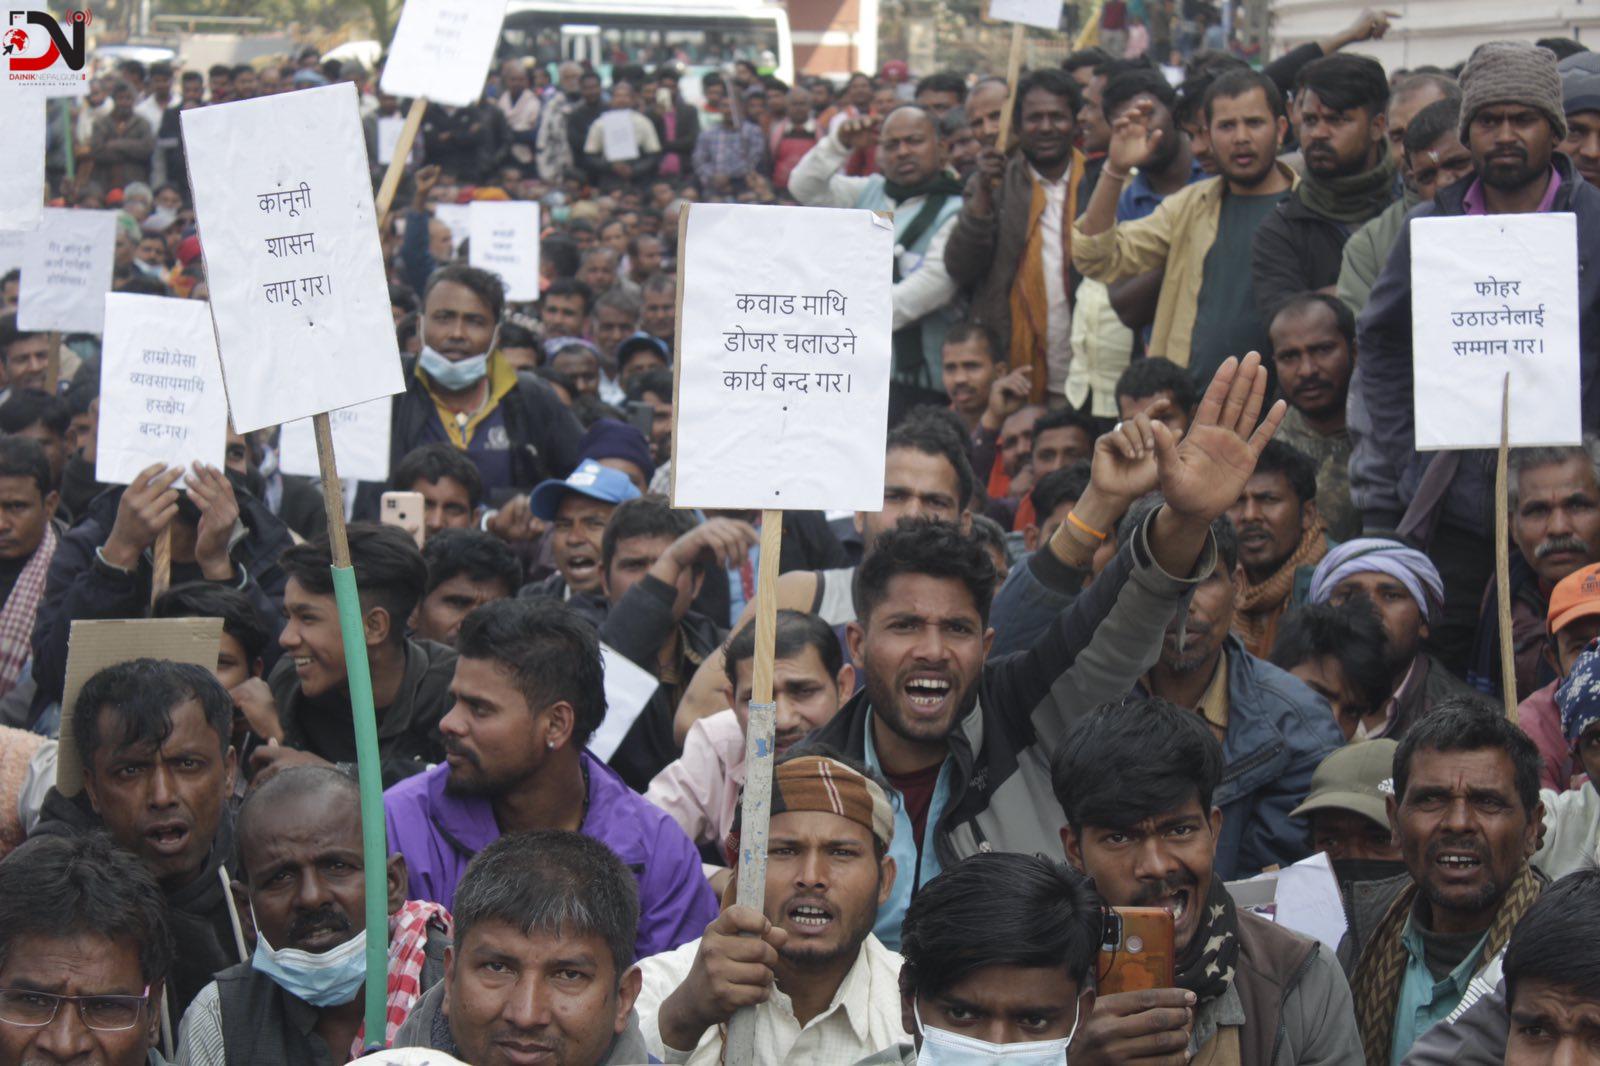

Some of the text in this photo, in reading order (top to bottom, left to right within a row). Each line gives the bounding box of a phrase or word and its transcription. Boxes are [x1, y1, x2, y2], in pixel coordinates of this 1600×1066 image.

[257, 181, 311, 217] कानूनी
[265, 233, 315, 258] शासन
[263, 274, 331, 306] लागू गर।
[1474, 276, 1521, 298] फोहर
[735, 289, 848, 316] कवाड माथि
[1451, 304, 1545, 328] उठाउनेलाई
[722, 325, 857, 355] डोजर चलाउने
[1452, 339, 1543, 356] सम्मान गर।
[722, 364, 851, 394] कार्य बन्द गर।
